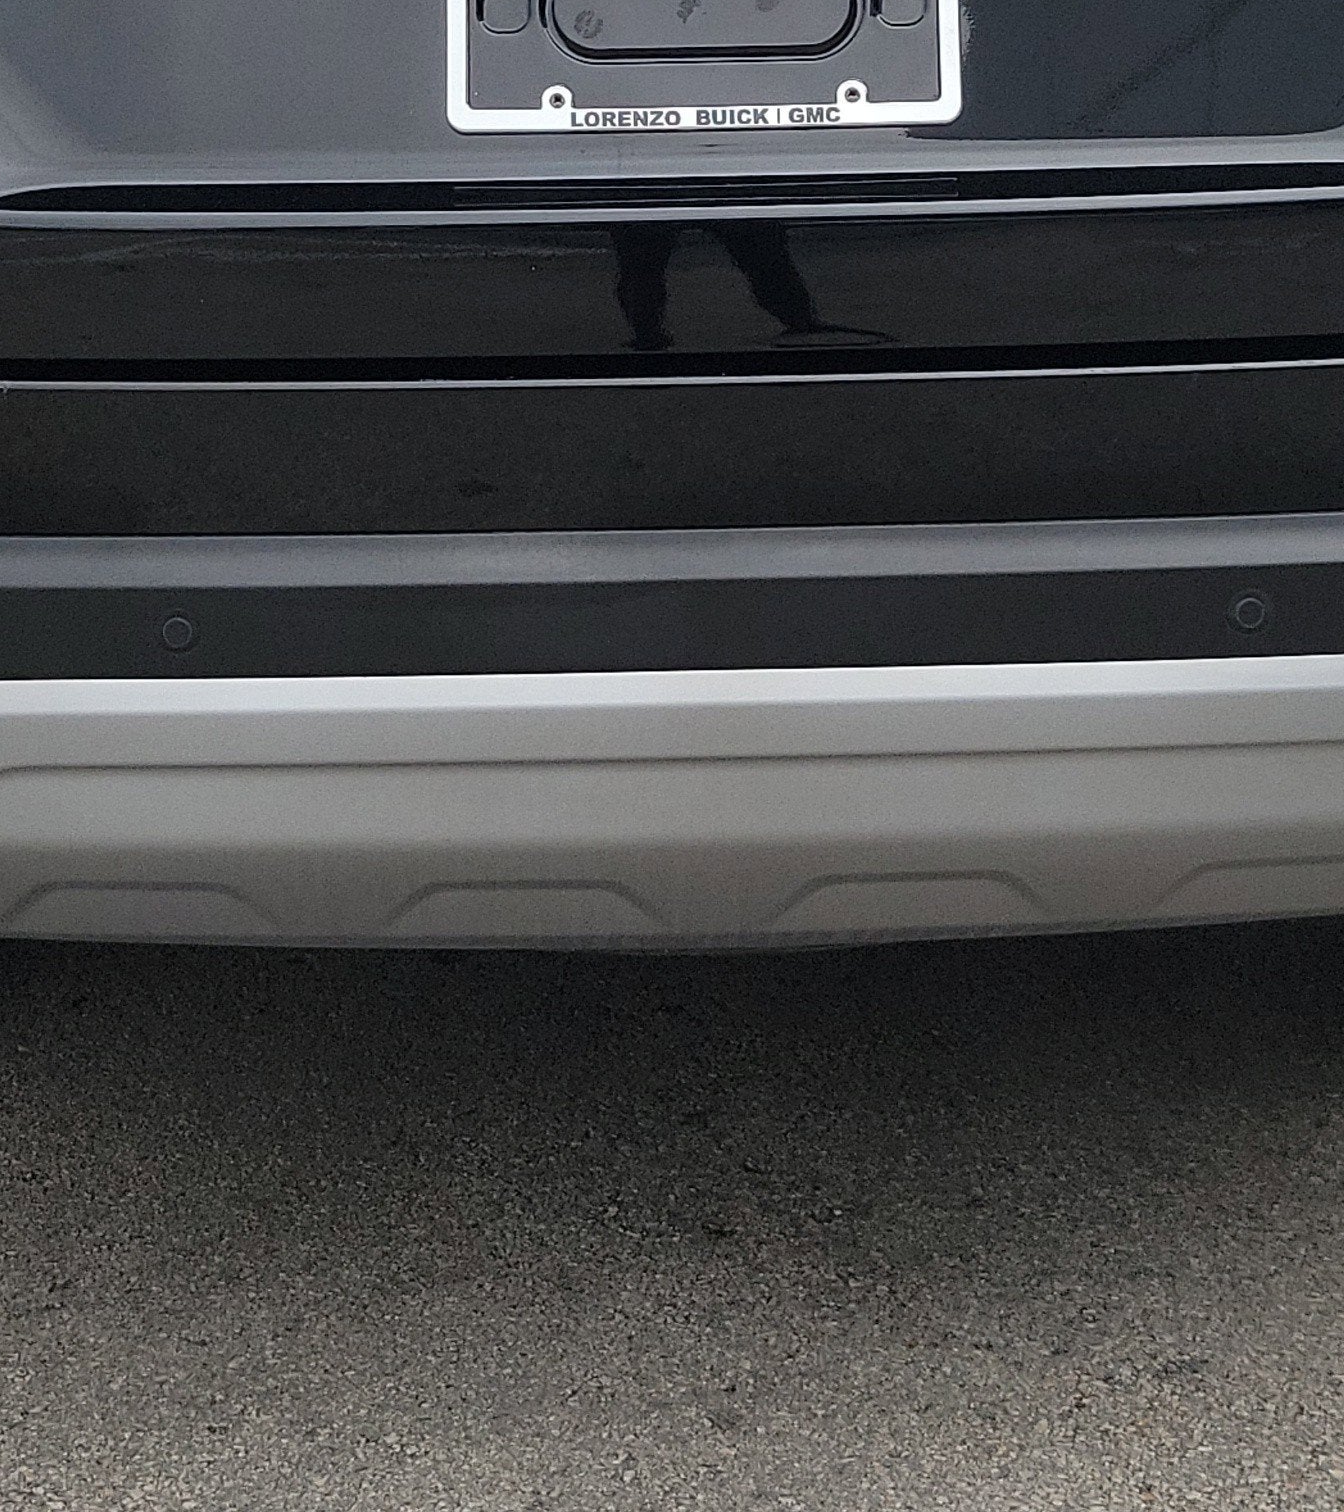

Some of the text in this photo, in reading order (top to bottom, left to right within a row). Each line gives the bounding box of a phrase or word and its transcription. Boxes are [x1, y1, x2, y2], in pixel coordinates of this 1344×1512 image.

[570, 106, 842, 128] LORENZO BUICK GMC
